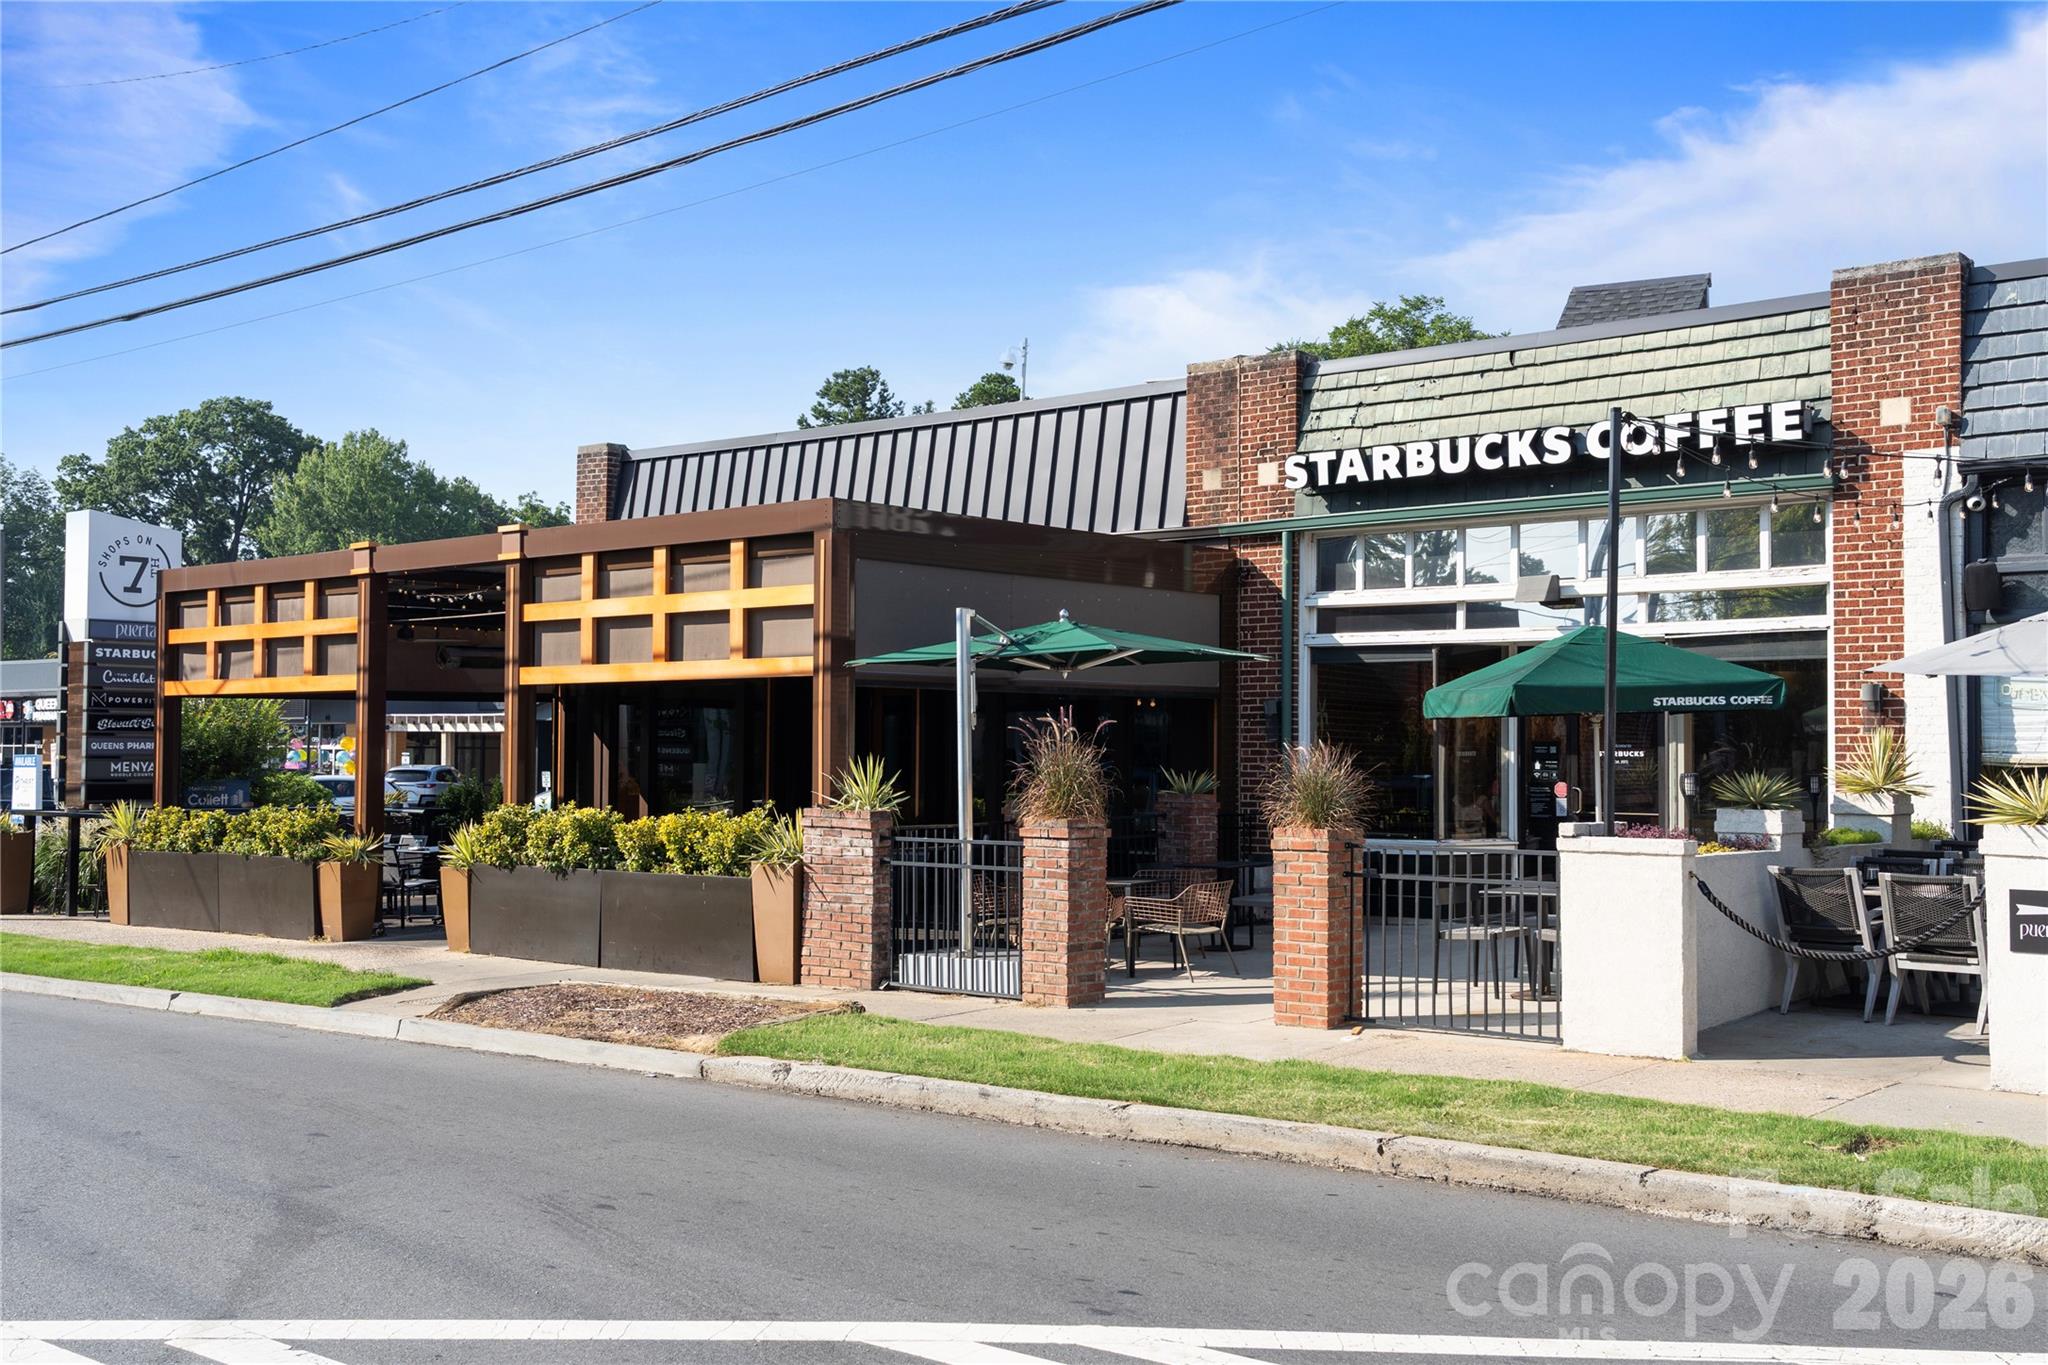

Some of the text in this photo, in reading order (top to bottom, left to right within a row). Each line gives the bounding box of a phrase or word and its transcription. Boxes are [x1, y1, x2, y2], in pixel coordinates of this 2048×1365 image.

[1284, 400, 1802, 489] STARBUCKS COFFEE
[98, 535, 152, 568] SHOPS ON
[119, 555, 149, 593] 7
[1653, 696, 1726, 706] STARBUCKS
[91, 742, 154, 750] QUEENS PHAR
[110, 761, 154, 773] MENYA
